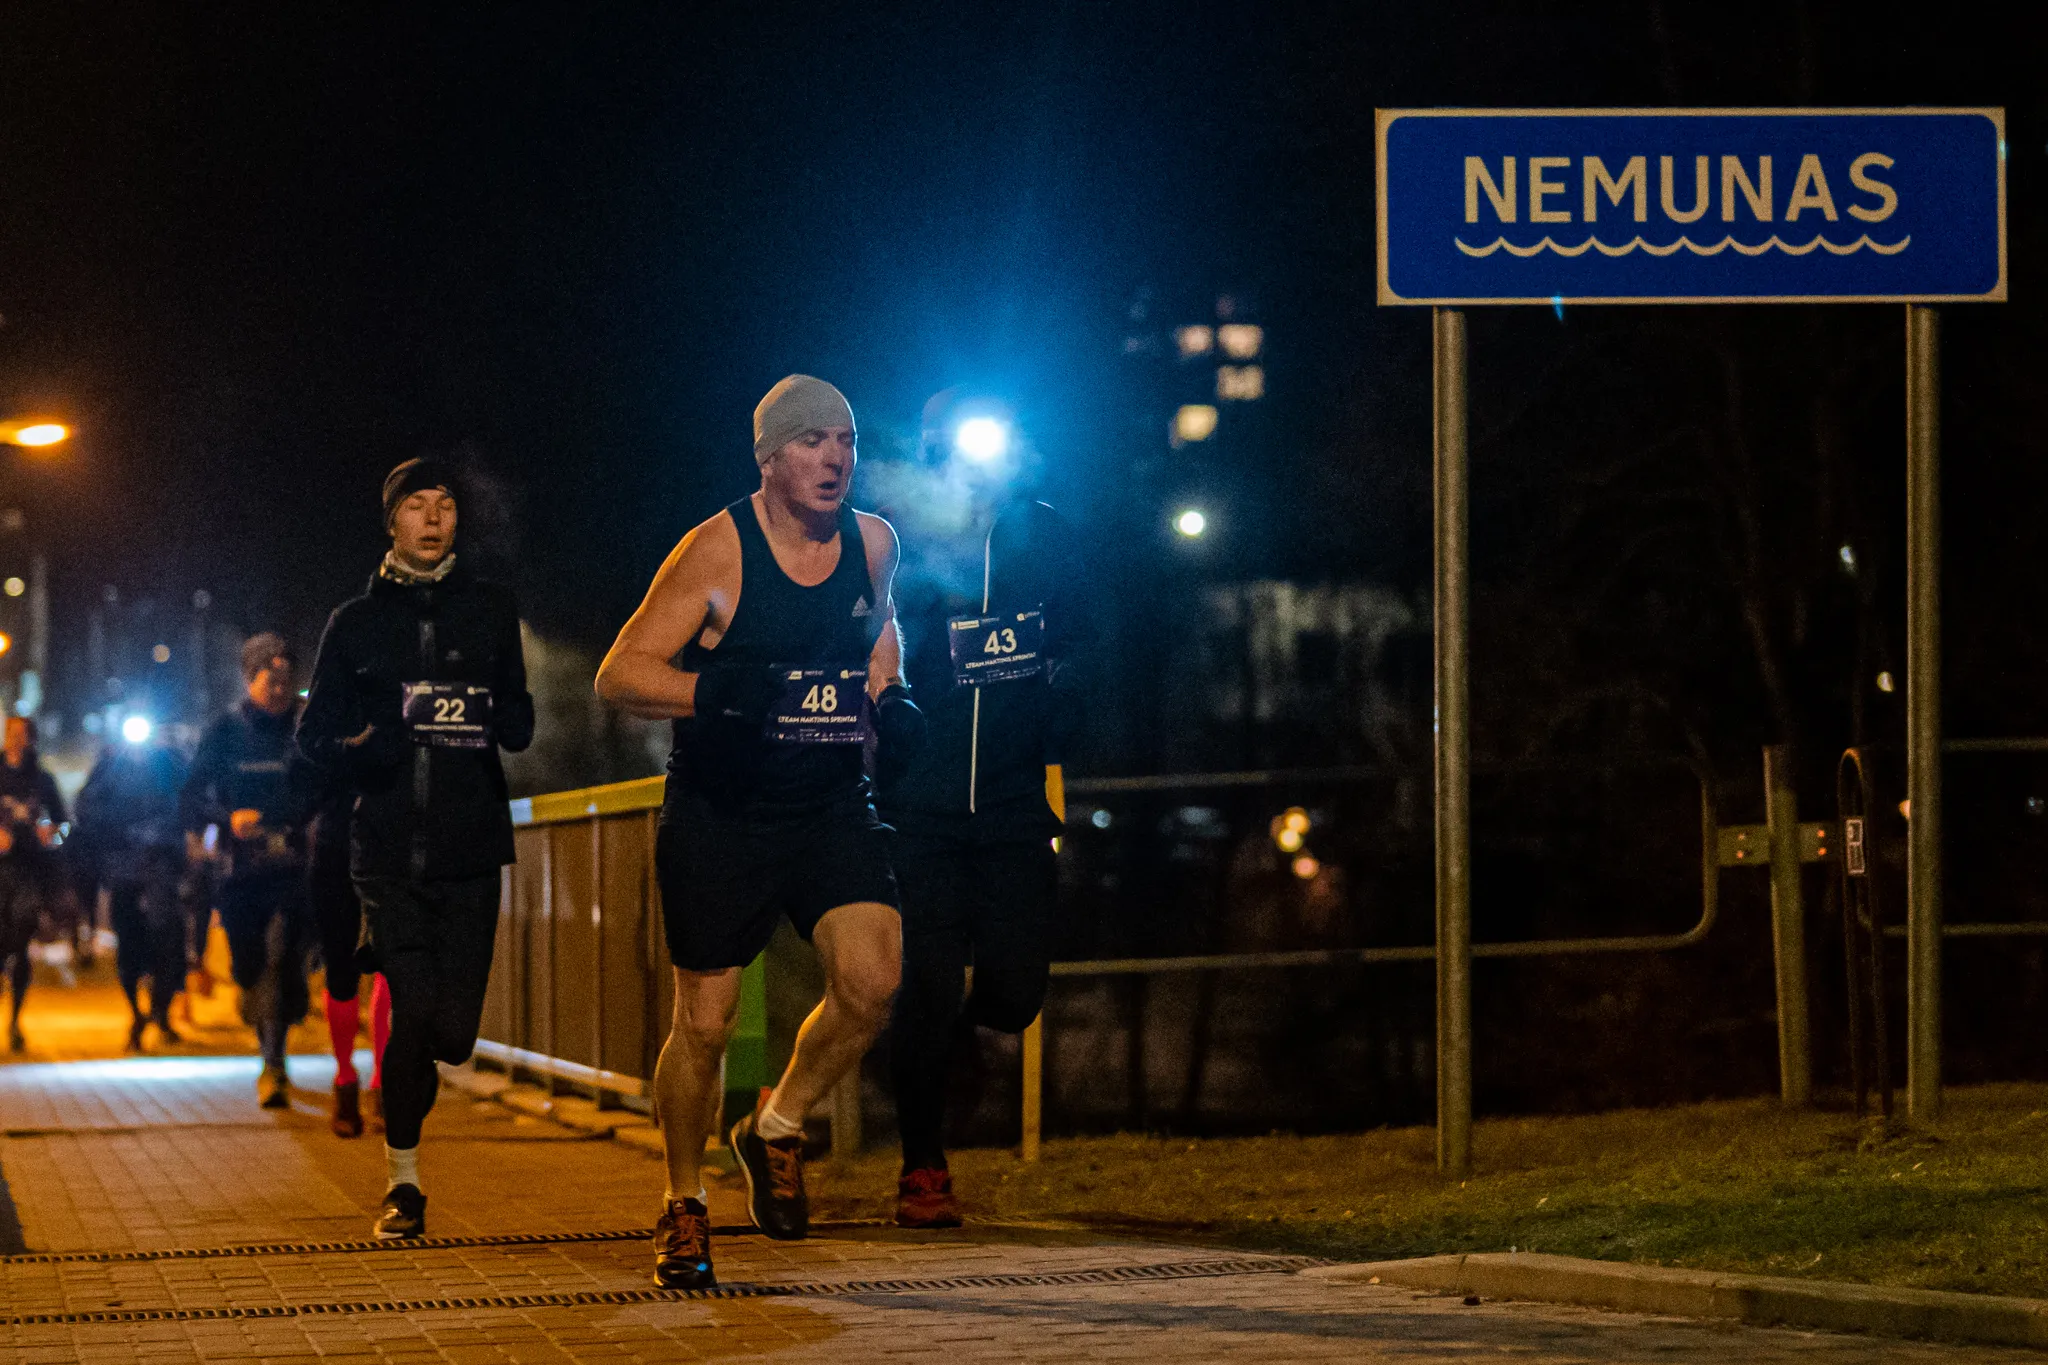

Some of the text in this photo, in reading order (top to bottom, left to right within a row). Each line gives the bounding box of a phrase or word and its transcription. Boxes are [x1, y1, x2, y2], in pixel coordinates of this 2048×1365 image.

[1464, 151, 1899, 224] NEMUNAS
[984, 628, 1017, 655] 43
[434, 698, 465, 722] 22
[801, 684, 838, 713] 48
